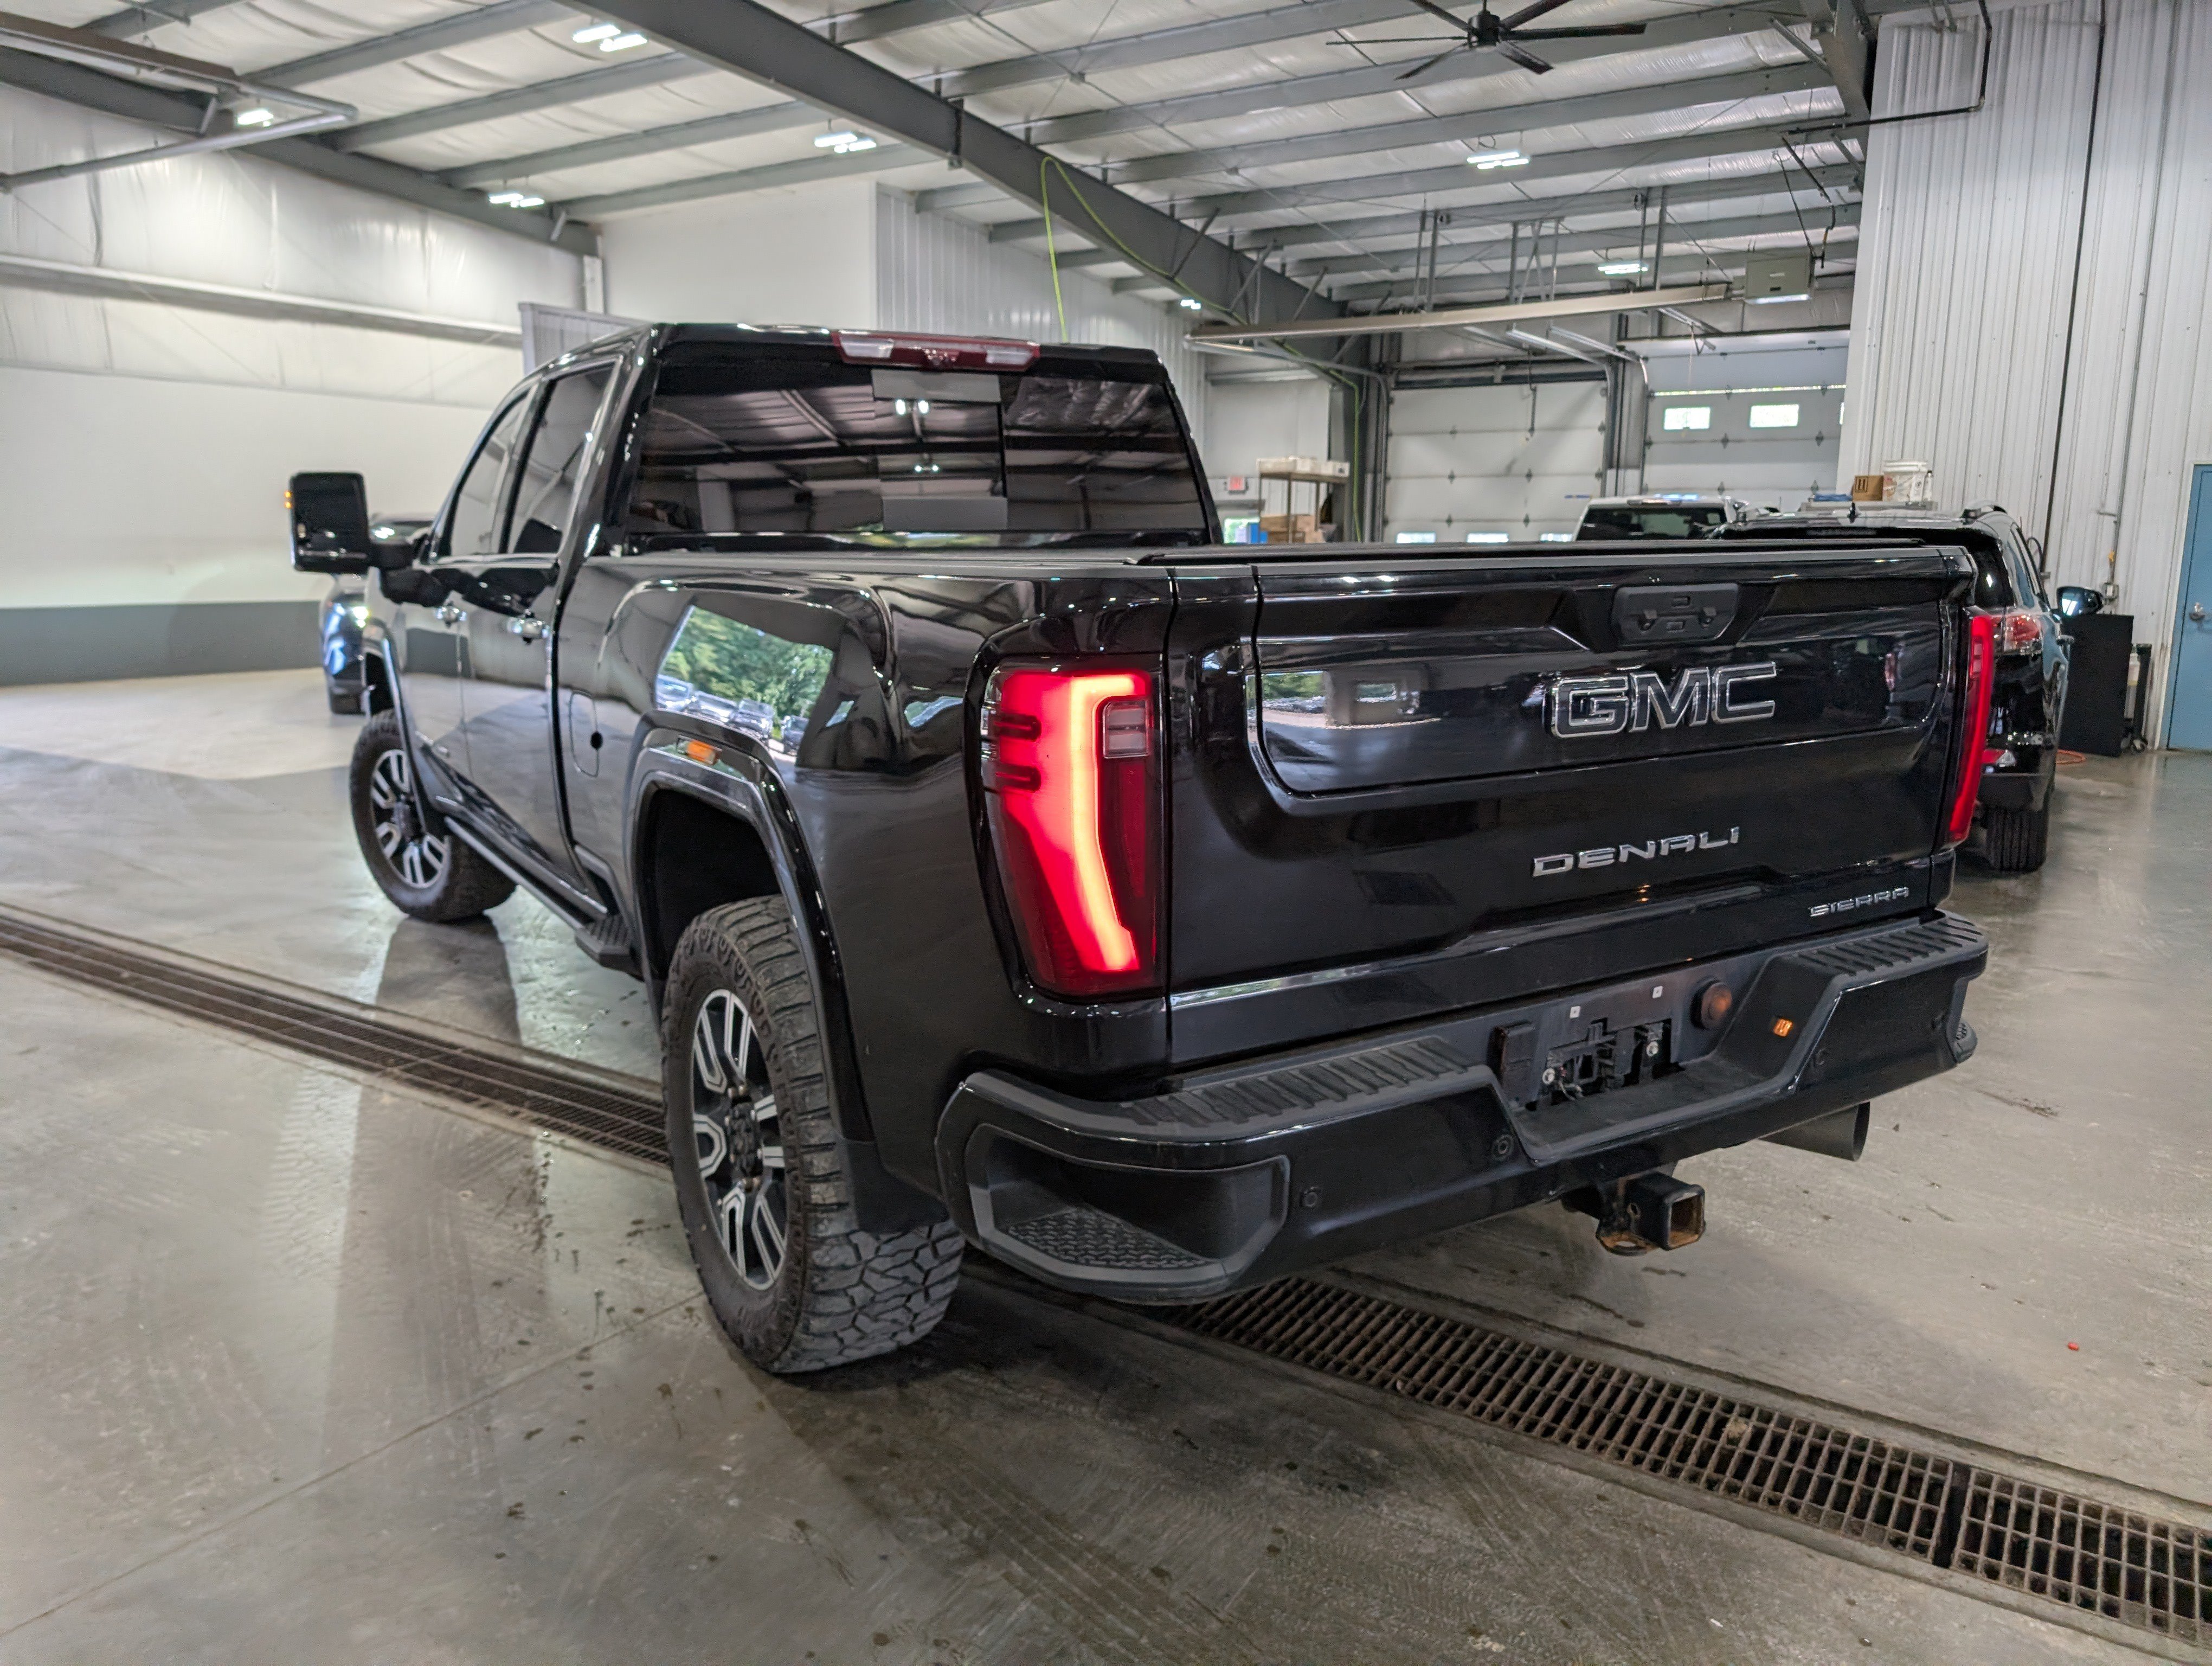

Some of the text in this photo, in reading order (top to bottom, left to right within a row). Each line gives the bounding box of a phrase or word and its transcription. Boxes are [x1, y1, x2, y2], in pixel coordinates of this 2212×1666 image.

[1551, 661, 1777, 739] GMC
[1532, 826, 1740, 877] DENALI
[1808, 887, 1909, 917] SIERRA
